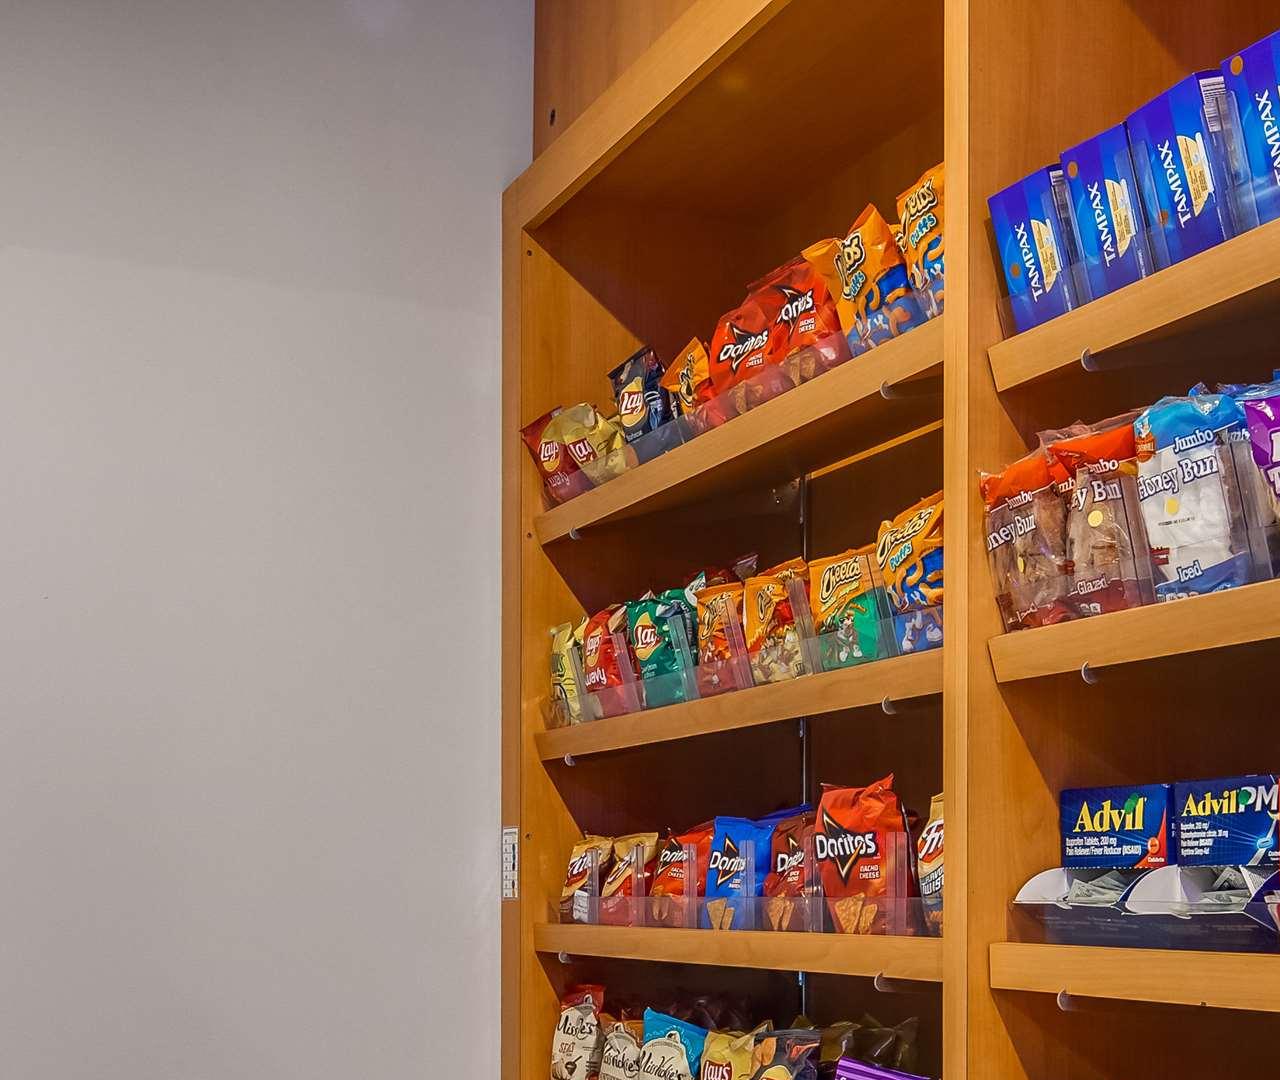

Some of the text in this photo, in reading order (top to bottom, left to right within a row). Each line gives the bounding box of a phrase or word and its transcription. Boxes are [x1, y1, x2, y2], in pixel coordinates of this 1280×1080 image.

[1158, 140, 1192, 229] TAMPAX
[910, 213, 937, 249] Puffs
[1088, 182, 1116, 268] TAMPAX
[1015, 222, 1044, 303] TAMPAX
[719, 329, 769, 361] Doritos
[1173, 428, 1215, 453] Jumbo
[1178, 452, 1220, 485] Bun
[889, 542, 913, 572] Puffs
[1176, 560, 1203, 583] Iced
[819, 556, 862, 604] Cheetos
[1076, 575, 1110, 596] Glazed
[1073, 797, 1144, 832] Advil
[1181, 784, 1279, 817] Advil PM
[709, 851, 747, 873] Doritos
[815, 833, 877, 860] Doritos
[859, 864, 879, 872] NACHO
[859, 871, 880, 880] CHEESE
